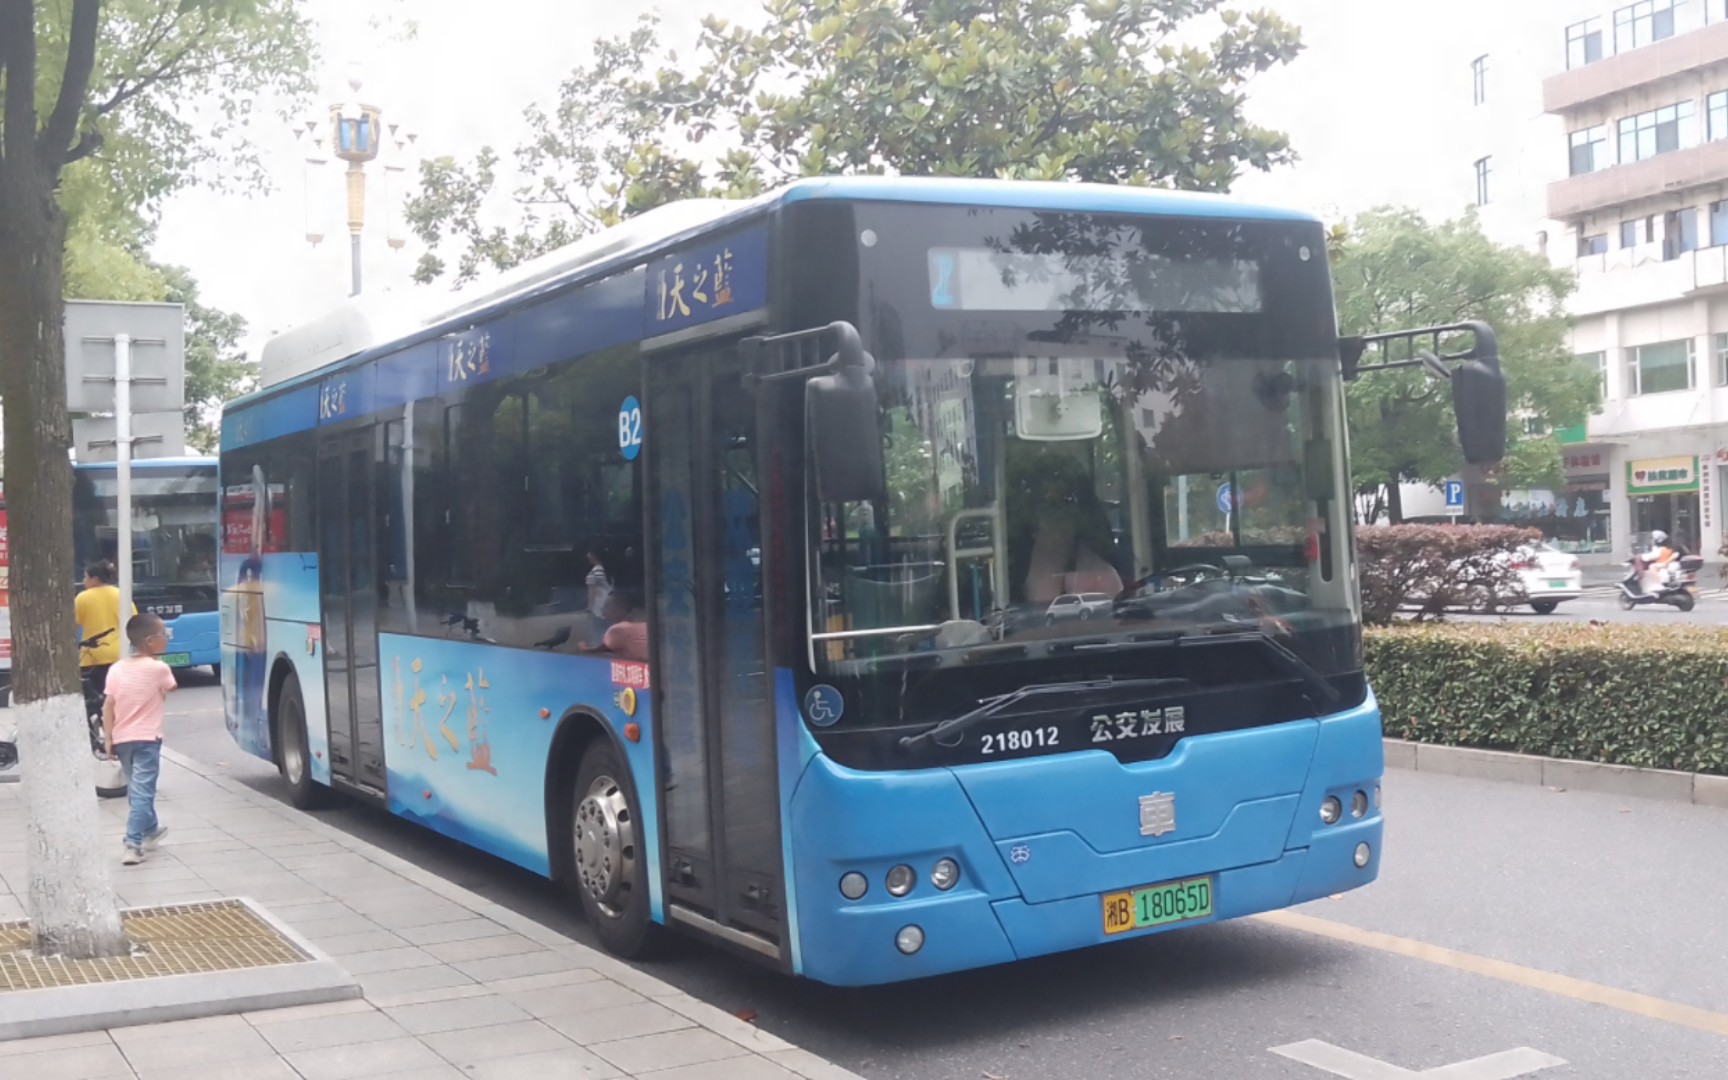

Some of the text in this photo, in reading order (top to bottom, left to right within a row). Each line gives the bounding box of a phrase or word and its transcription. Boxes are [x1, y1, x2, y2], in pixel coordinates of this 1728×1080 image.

[619, 407, 642, 448] B2
[1449, 483, 1461, 503] P
[1090, 706, 1185, 742] 公交发展
[981, 727, 1060, 753] 218012
